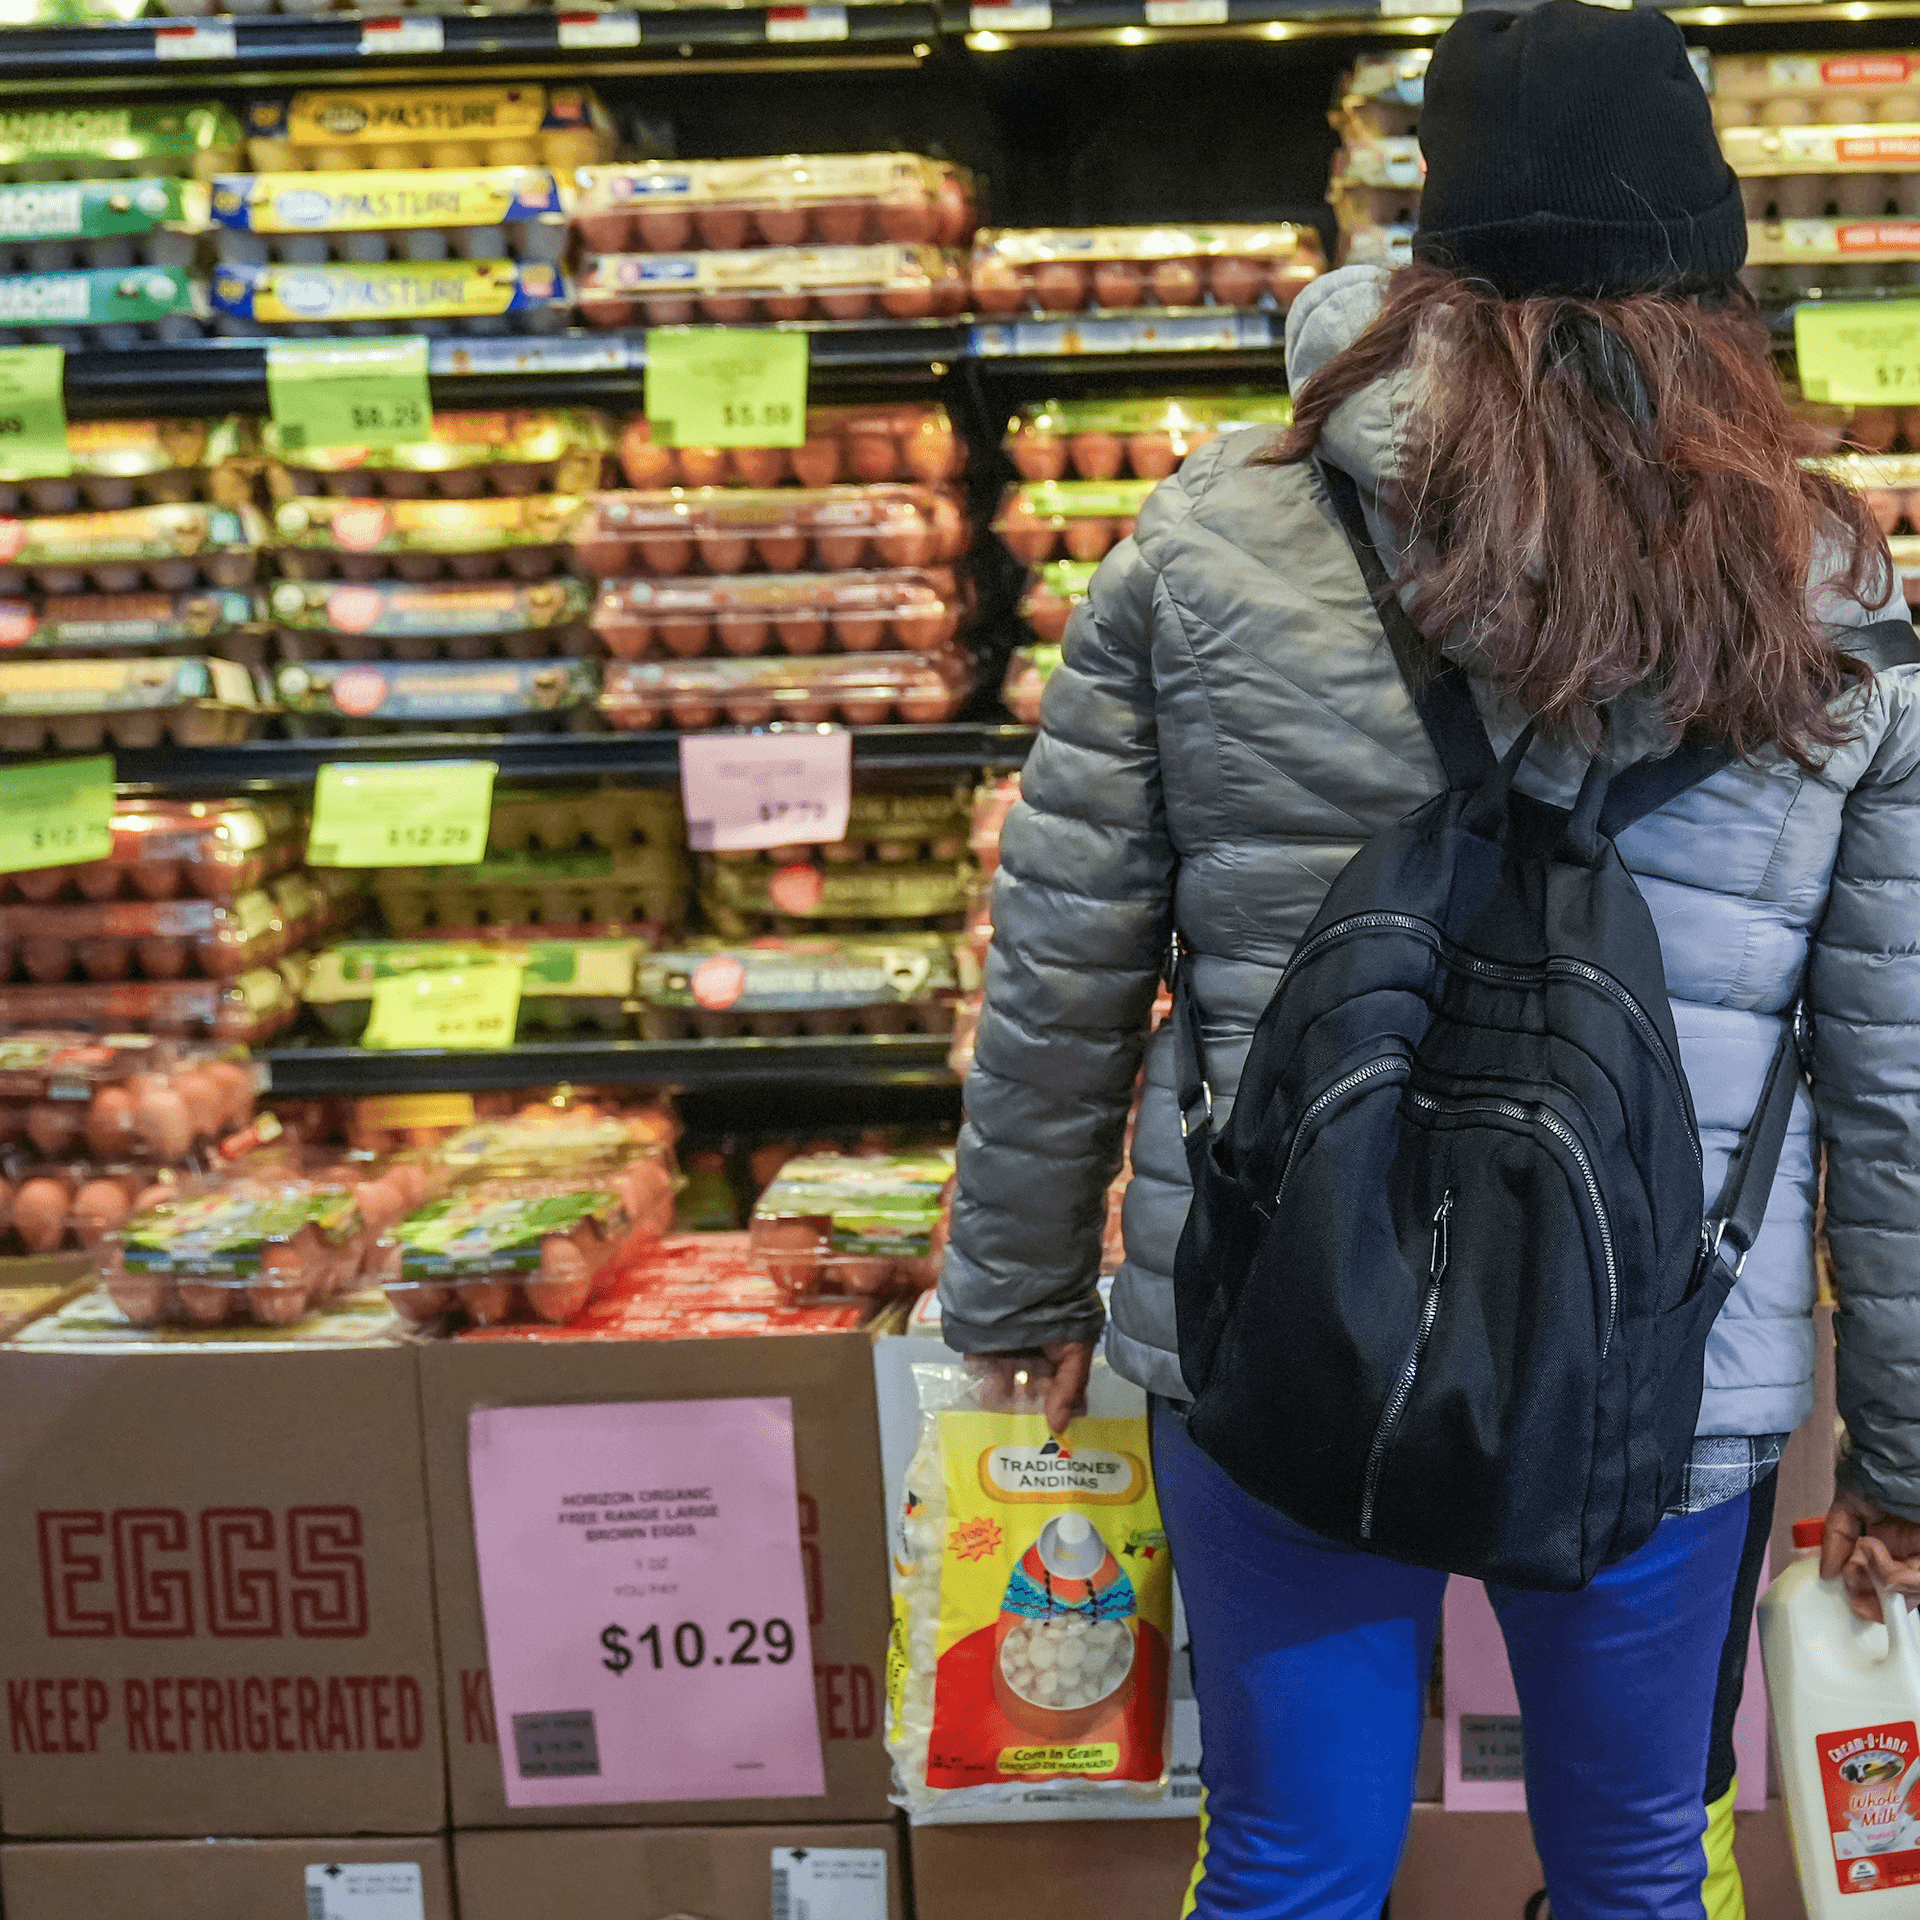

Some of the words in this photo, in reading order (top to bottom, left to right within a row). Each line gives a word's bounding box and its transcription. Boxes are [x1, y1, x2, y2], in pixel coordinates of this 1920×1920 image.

[999, 1457, 1118, 1475] TRADICIONES
[1019, 1475, 1099, 1490] ANDINAS
[562, 1491, 635, 1506] HORIZON
[638, 1486, 714, 1503] ORGANIC
[558, 1511, 597, 1525] FREE
[604, 1507, 660, 1522] RANGE
[665, 1503, 720, 1520] LARGE
[585, 1526, 648, 1543] BROWN
[651, 1522, 697, 1540] EGGS
[36, 1504, 370, 1639] EGGS
[601, 1617, 795, 1678] $10.29
[6, 1677, 110, 1755] KEEP
[122, 1674, 426, 1754] REFRIGERATED
[1013, 1749, 1046, 1761] Corn
[1050, 1748, 1064, 1759] In
[1067, 1747, 1103, 1760] Grain
[1850, 1789, 1901, 1810] Whole
[1861, 1807, 1898, 1828] Milk
